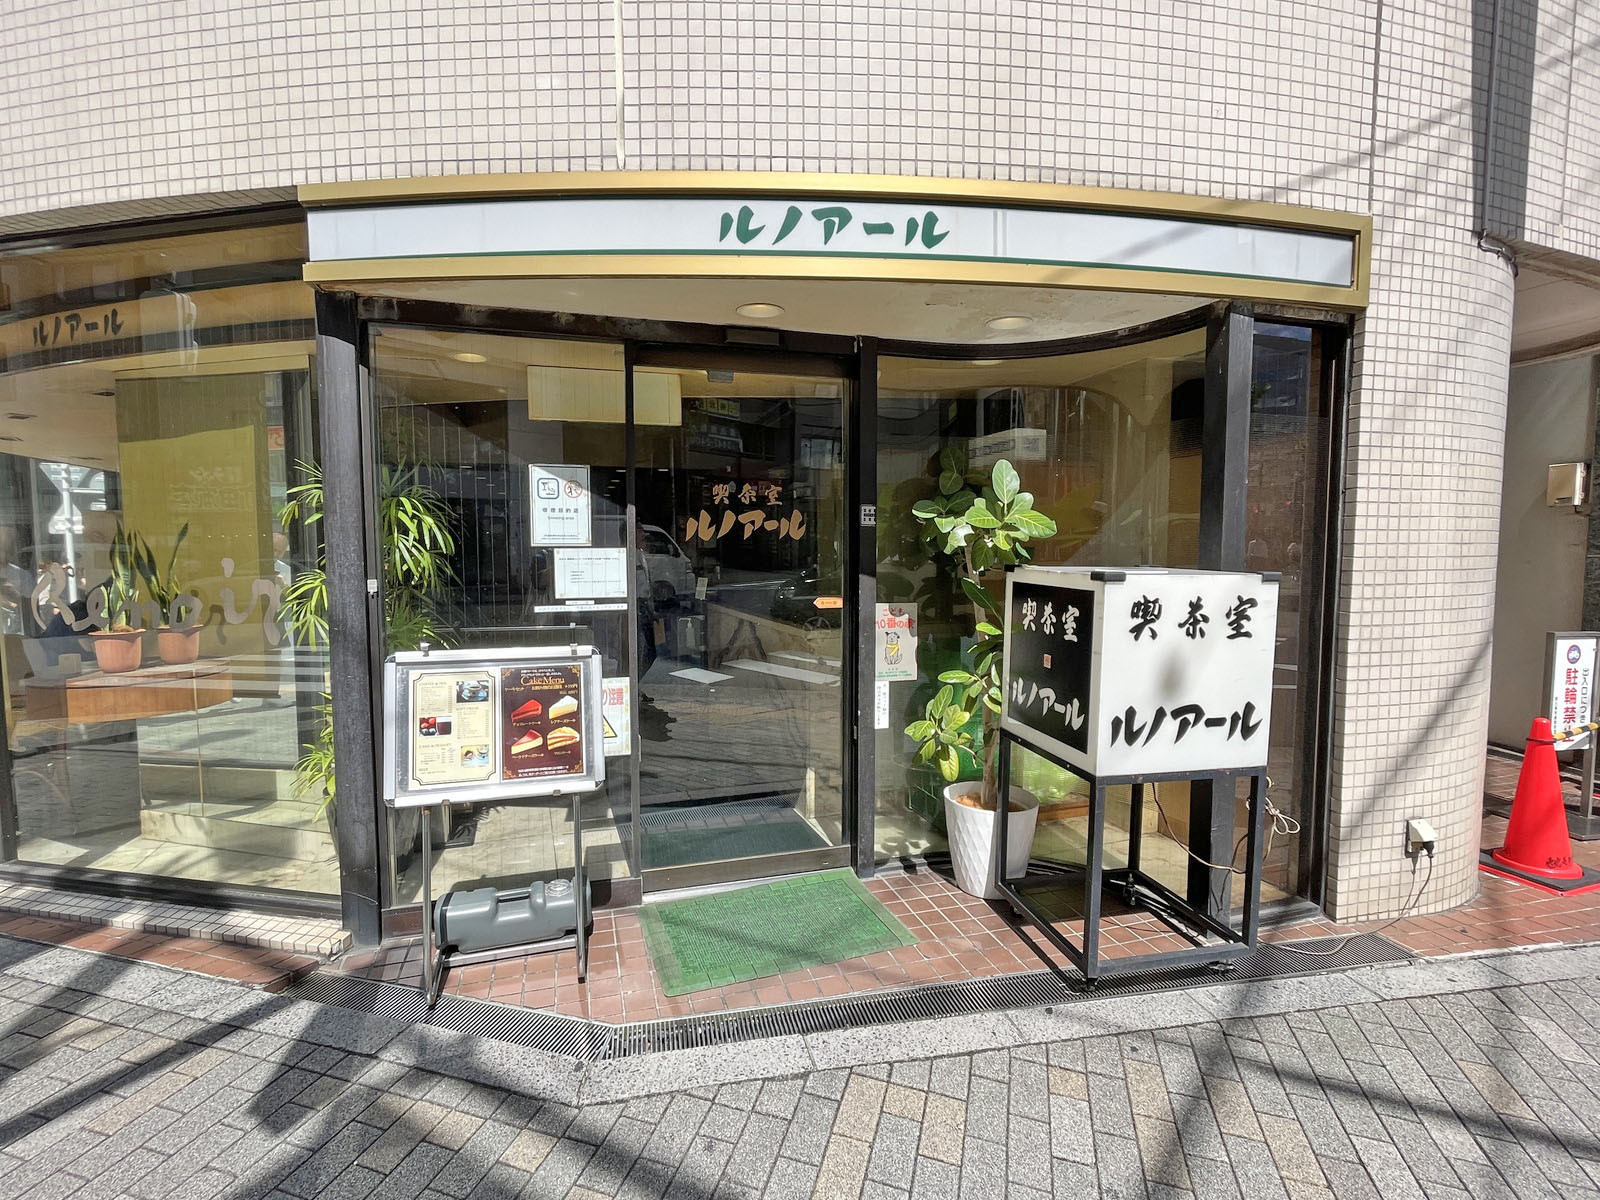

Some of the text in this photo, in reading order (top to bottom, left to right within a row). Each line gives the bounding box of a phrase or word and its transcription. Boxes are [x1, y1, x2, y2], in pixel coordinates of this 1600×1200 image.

[719, 205, 950, 249] ルノアール
[33, 308, 125, 347] ルノアール
[712, 483, 783, 506] 喫茶室
[685, 509, 807, 542] ルノアール
[1021, 598, 1080, 643] 喫茶室
[1129, 595, 1258, 641] 喫茶室
[520, 675, 565, 686] Cake Menu
[1012, 677, 1085, 732] ルノアール
[1110, 701, 1264, 748] ルノアール
